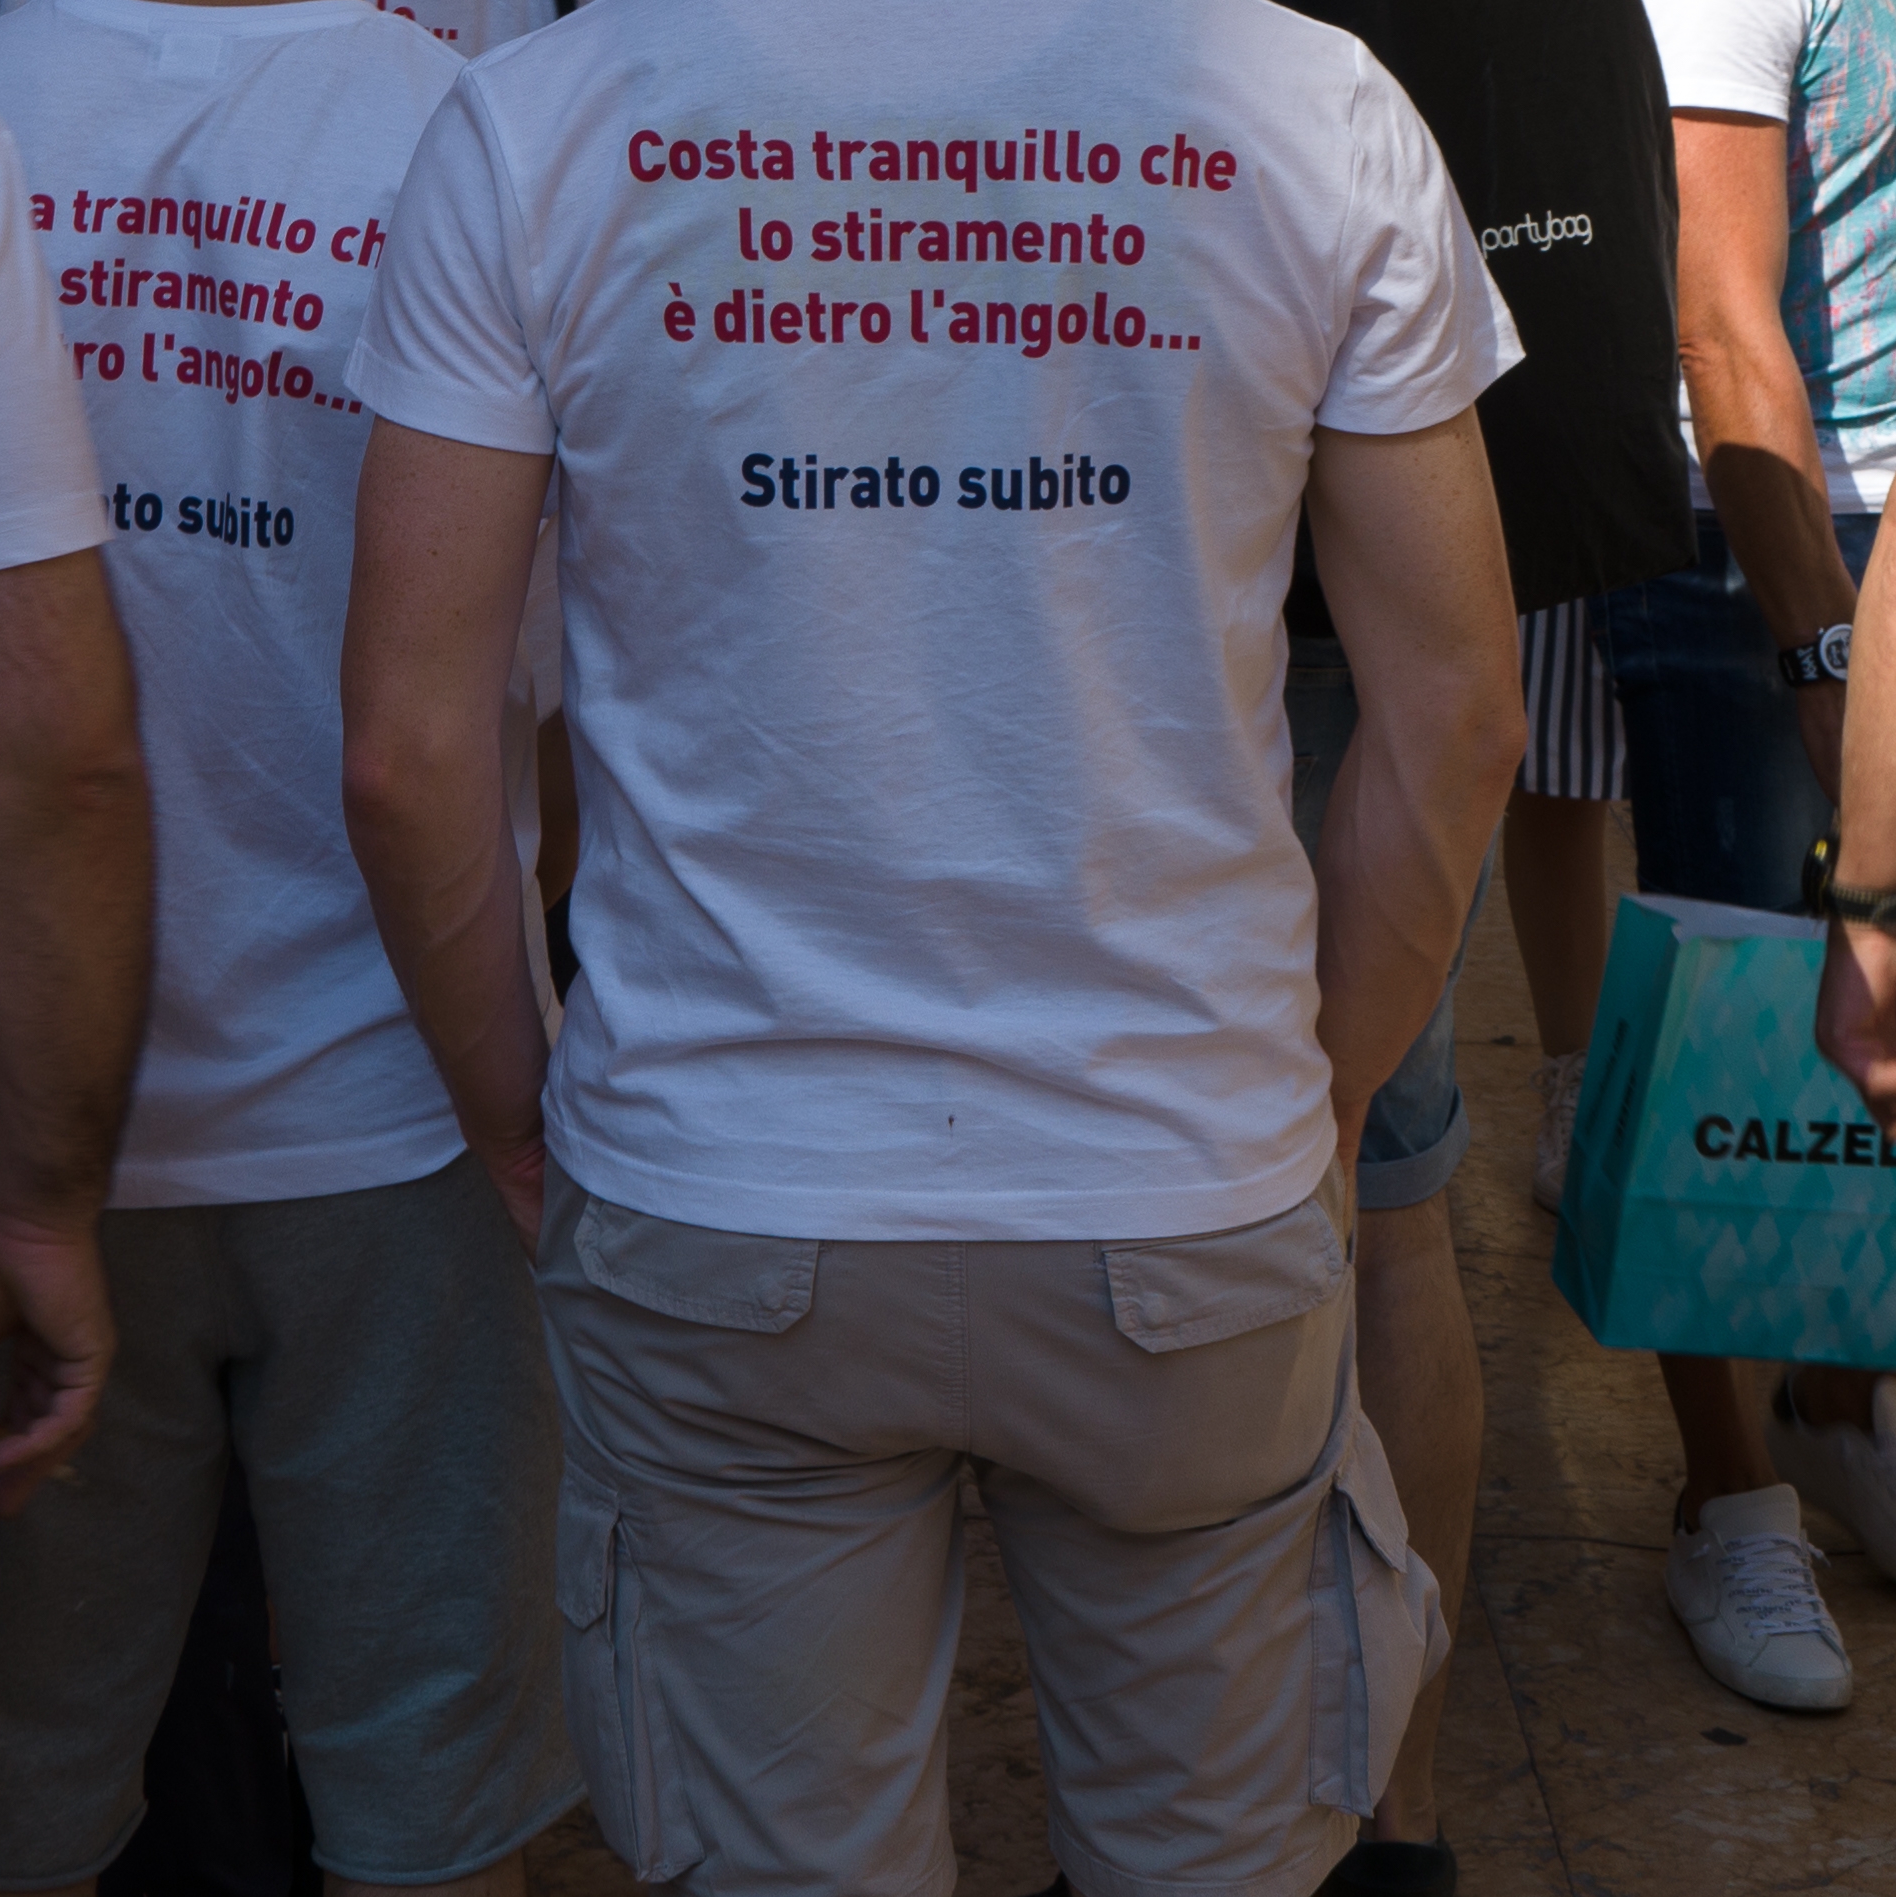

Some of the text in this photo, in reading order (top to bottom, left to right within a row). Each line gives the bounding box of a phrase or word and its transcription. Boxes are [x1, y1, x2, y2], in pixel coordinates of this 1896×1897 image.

[628, 128, 1239, 194] Costa tranquillo che
[72, 189, 317, 255] tranquillo
[738, 206, 1147, 267] lo stiramento
[1481, 210, 1593, 260] partybag
[58, 257, 325, 332] stiramento
[663, 282, 1202, 360] è dietro l'angolo...
[141, 332, 363, 415] l'angolo...
[739, 452, 1133, 512] Stirato subito
[177, 490, 295, 548] subito
